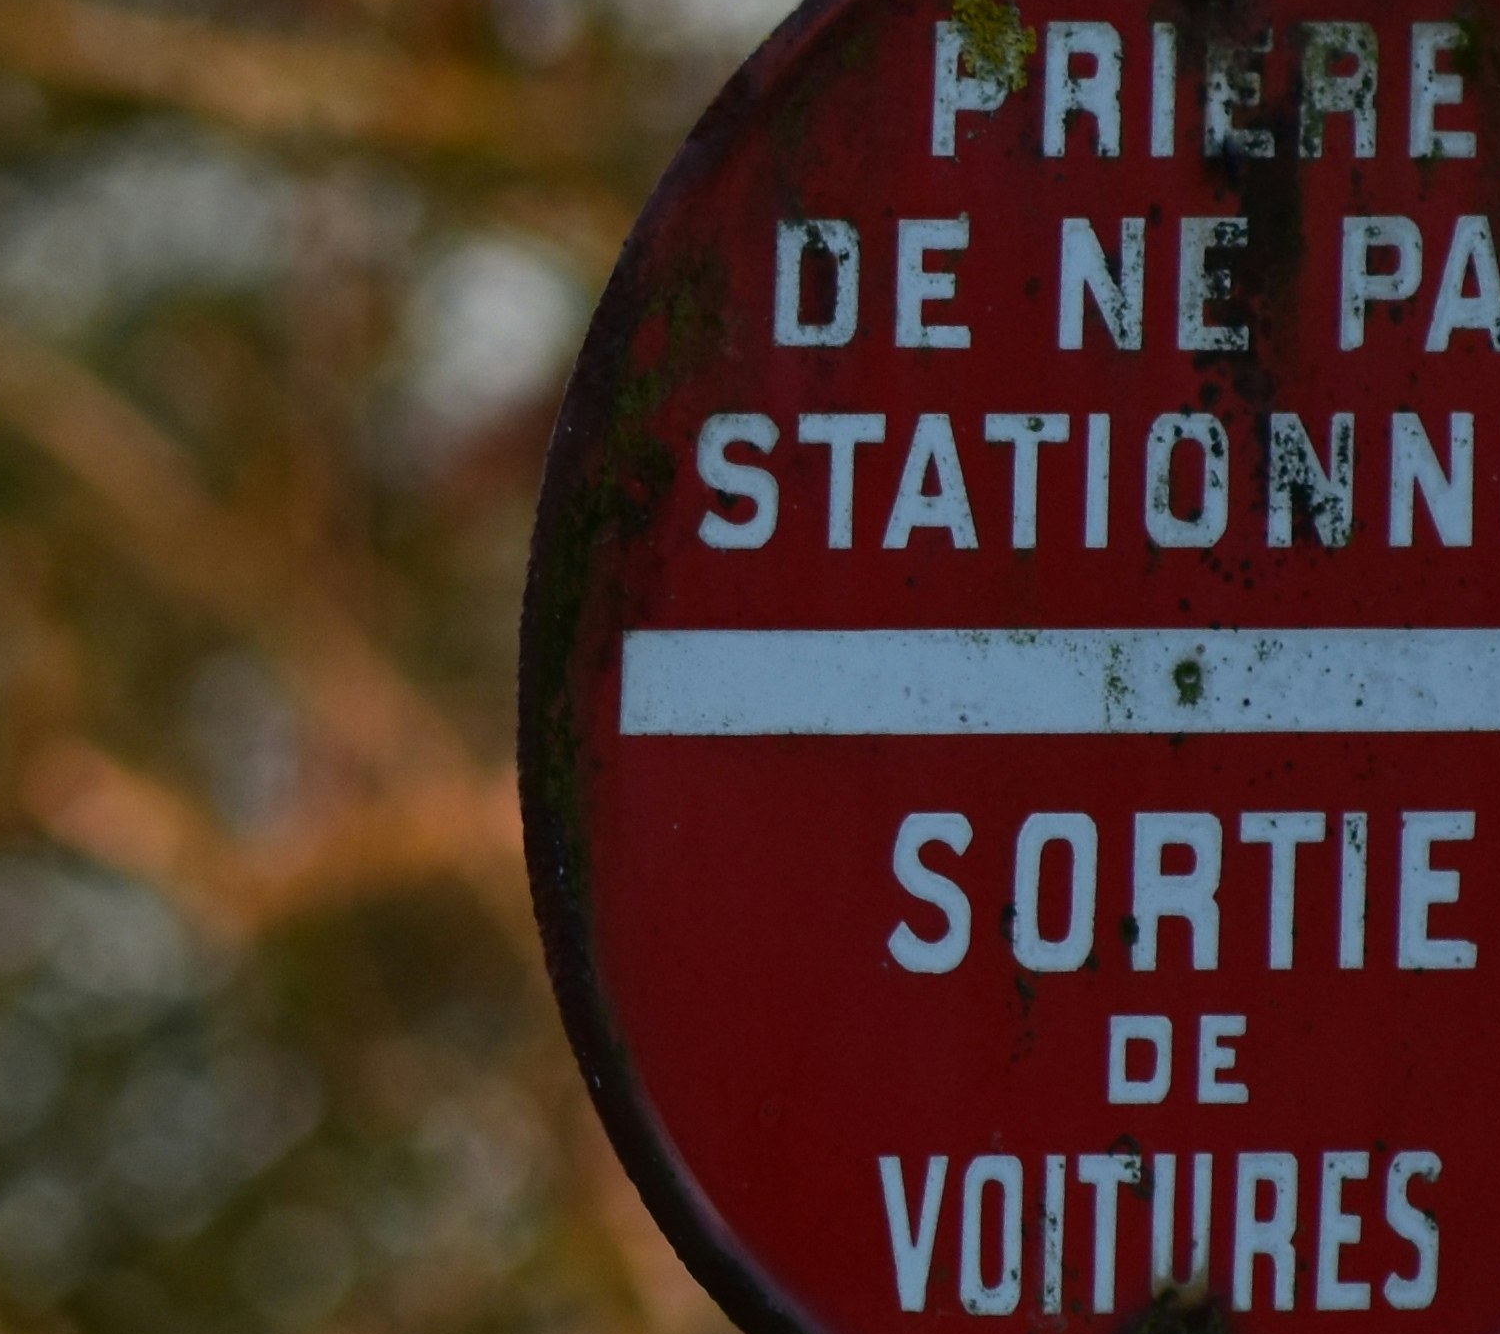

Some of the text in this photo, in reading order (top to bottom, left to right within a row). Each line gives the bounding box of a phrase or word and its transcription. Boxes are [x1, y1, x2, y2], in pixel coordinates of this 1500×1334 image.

[773, 218, 971, 348] DE
[1059, 217, 1250, 351] NE
[887, 811, 1478, 974] SORTIE
[1107, 1014, 1249, 1105] DE
[879, 1151, 1443, 1315] VOITURES
